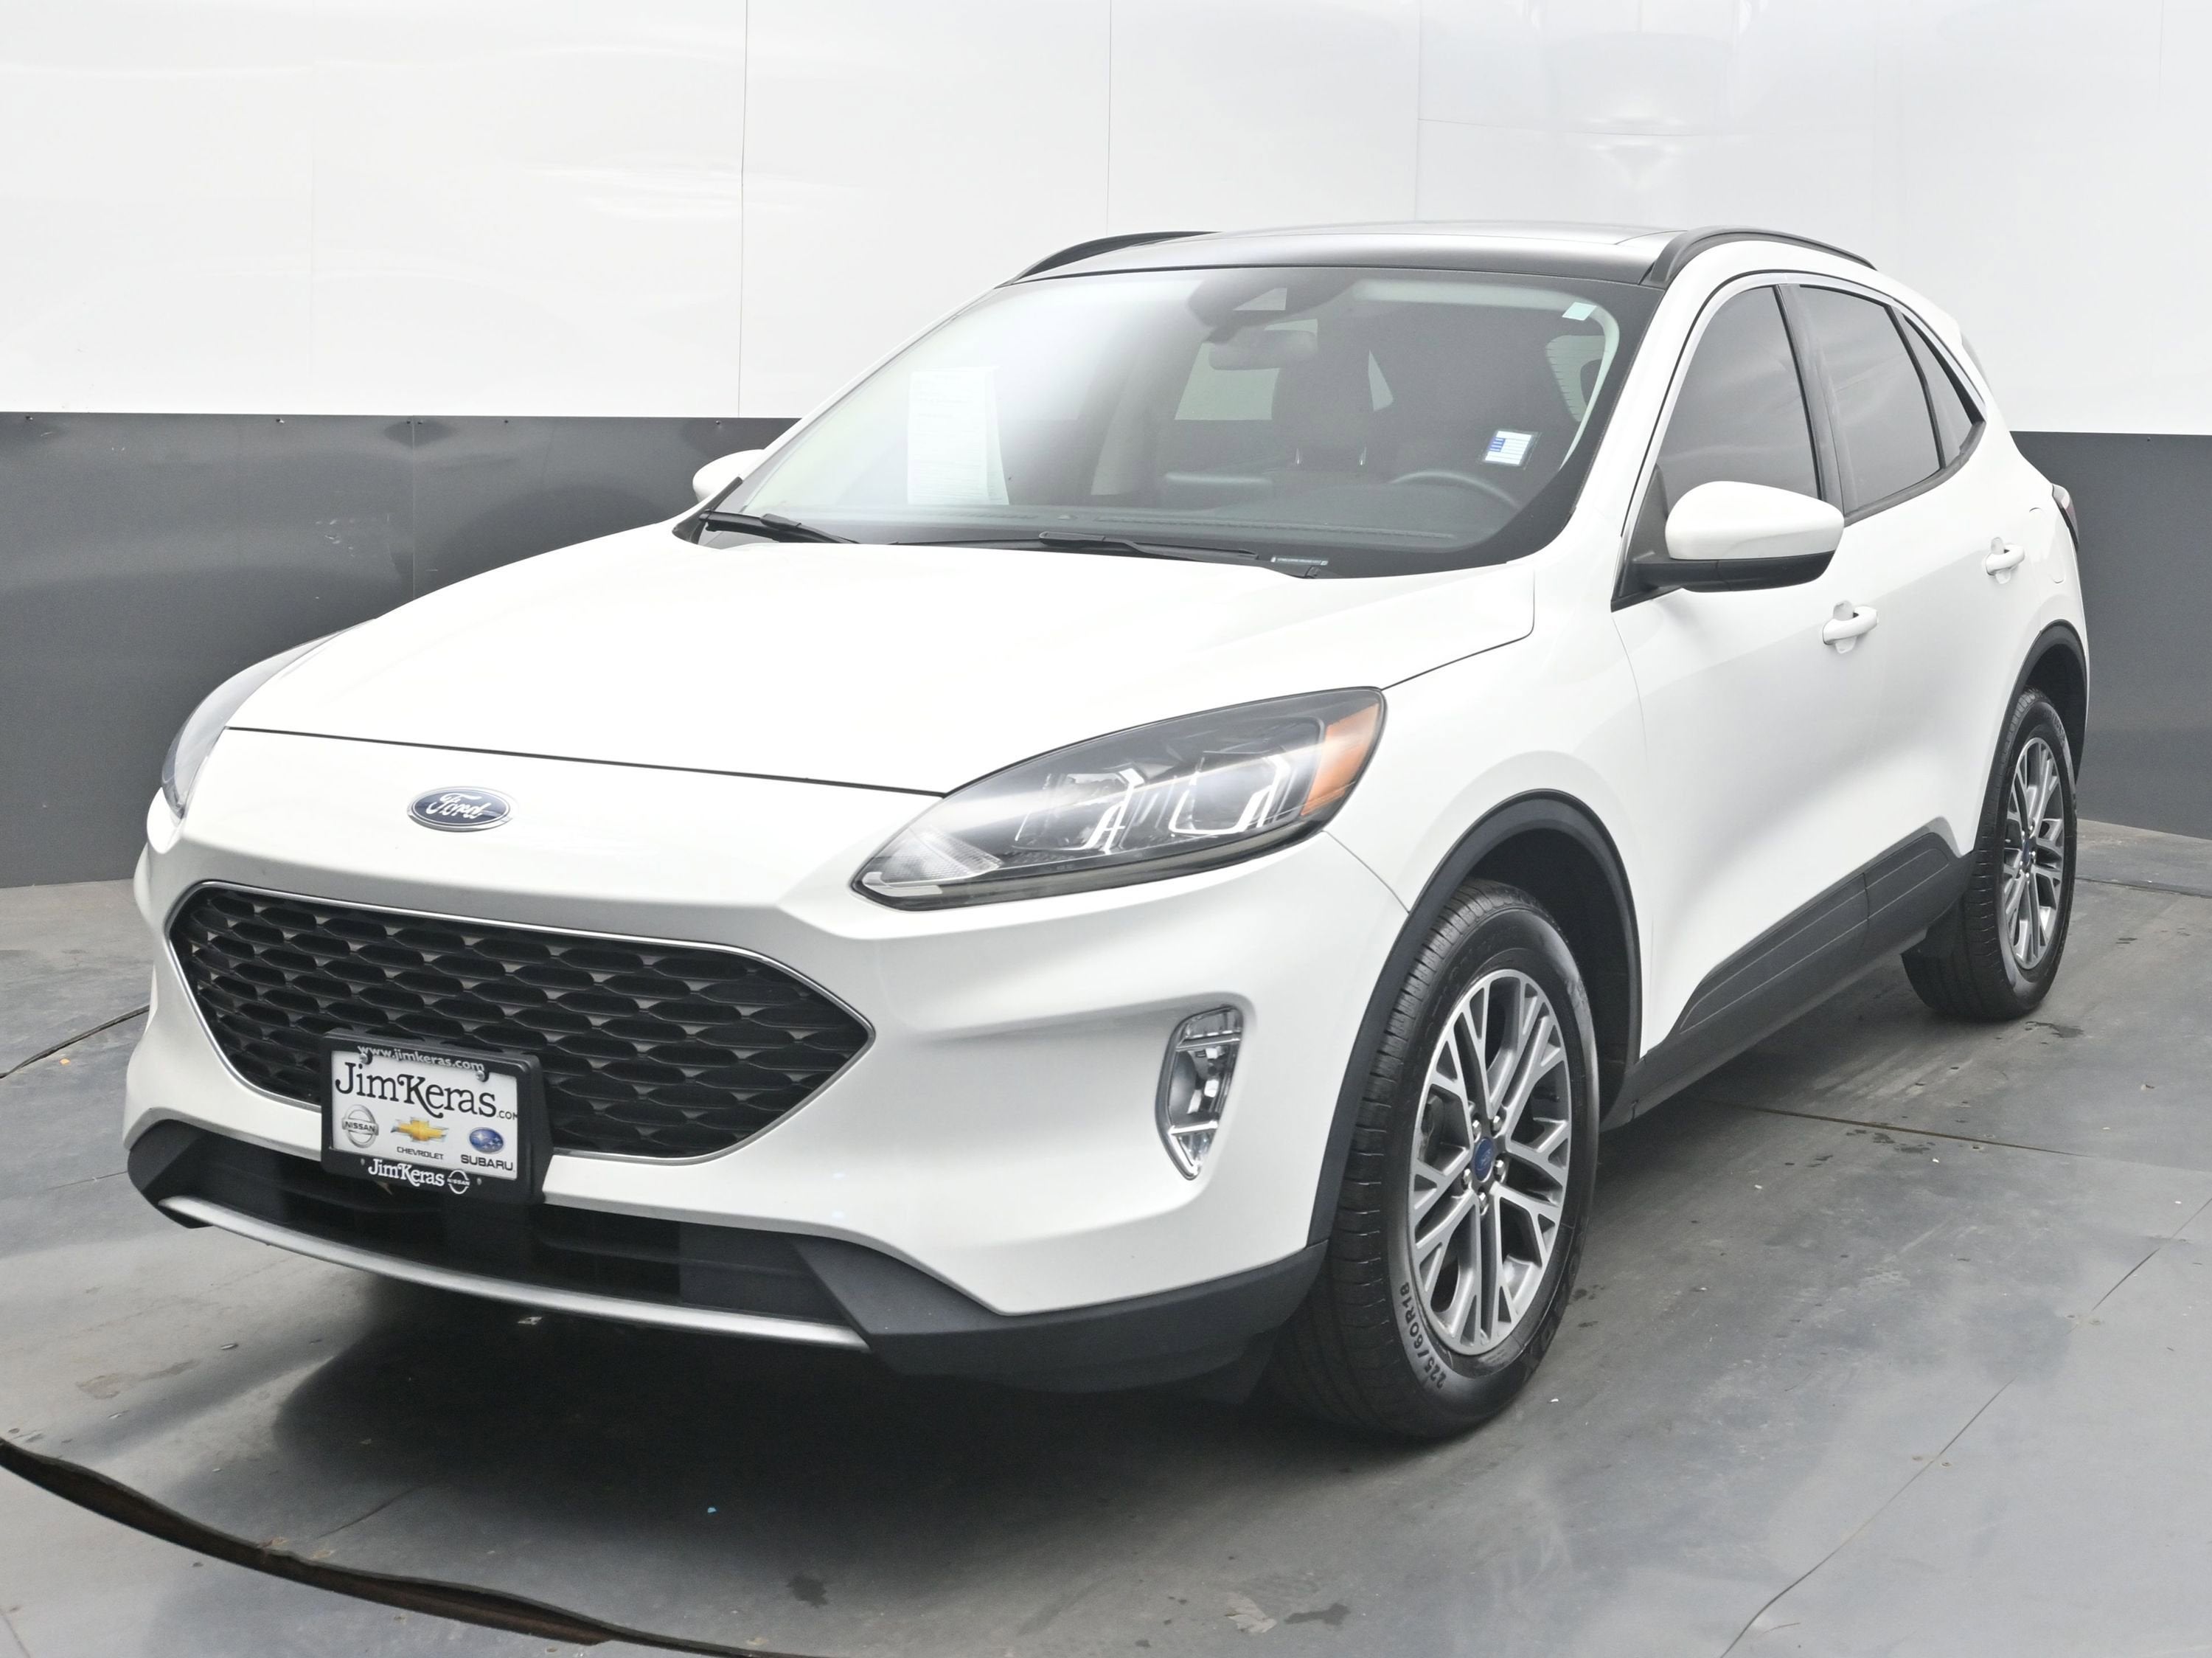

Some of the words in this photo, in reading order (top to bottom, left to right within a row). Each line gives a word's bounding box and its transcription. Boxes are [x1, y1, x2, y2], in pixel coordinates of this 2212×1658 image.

[425, 792, 492, 819] Ford
[357, 1045, 484, 1071] www.jimkeras.com
[344, 1121, 376, 1132] NISSAN
[397, 1146, 444, 1160] CHEVROLET
[460, 1154, 513, 1171] SUBARU
[368, 1158, 445, 1187] JimKeras
[1399, 1281, 1447, 1389] 225/60R18
